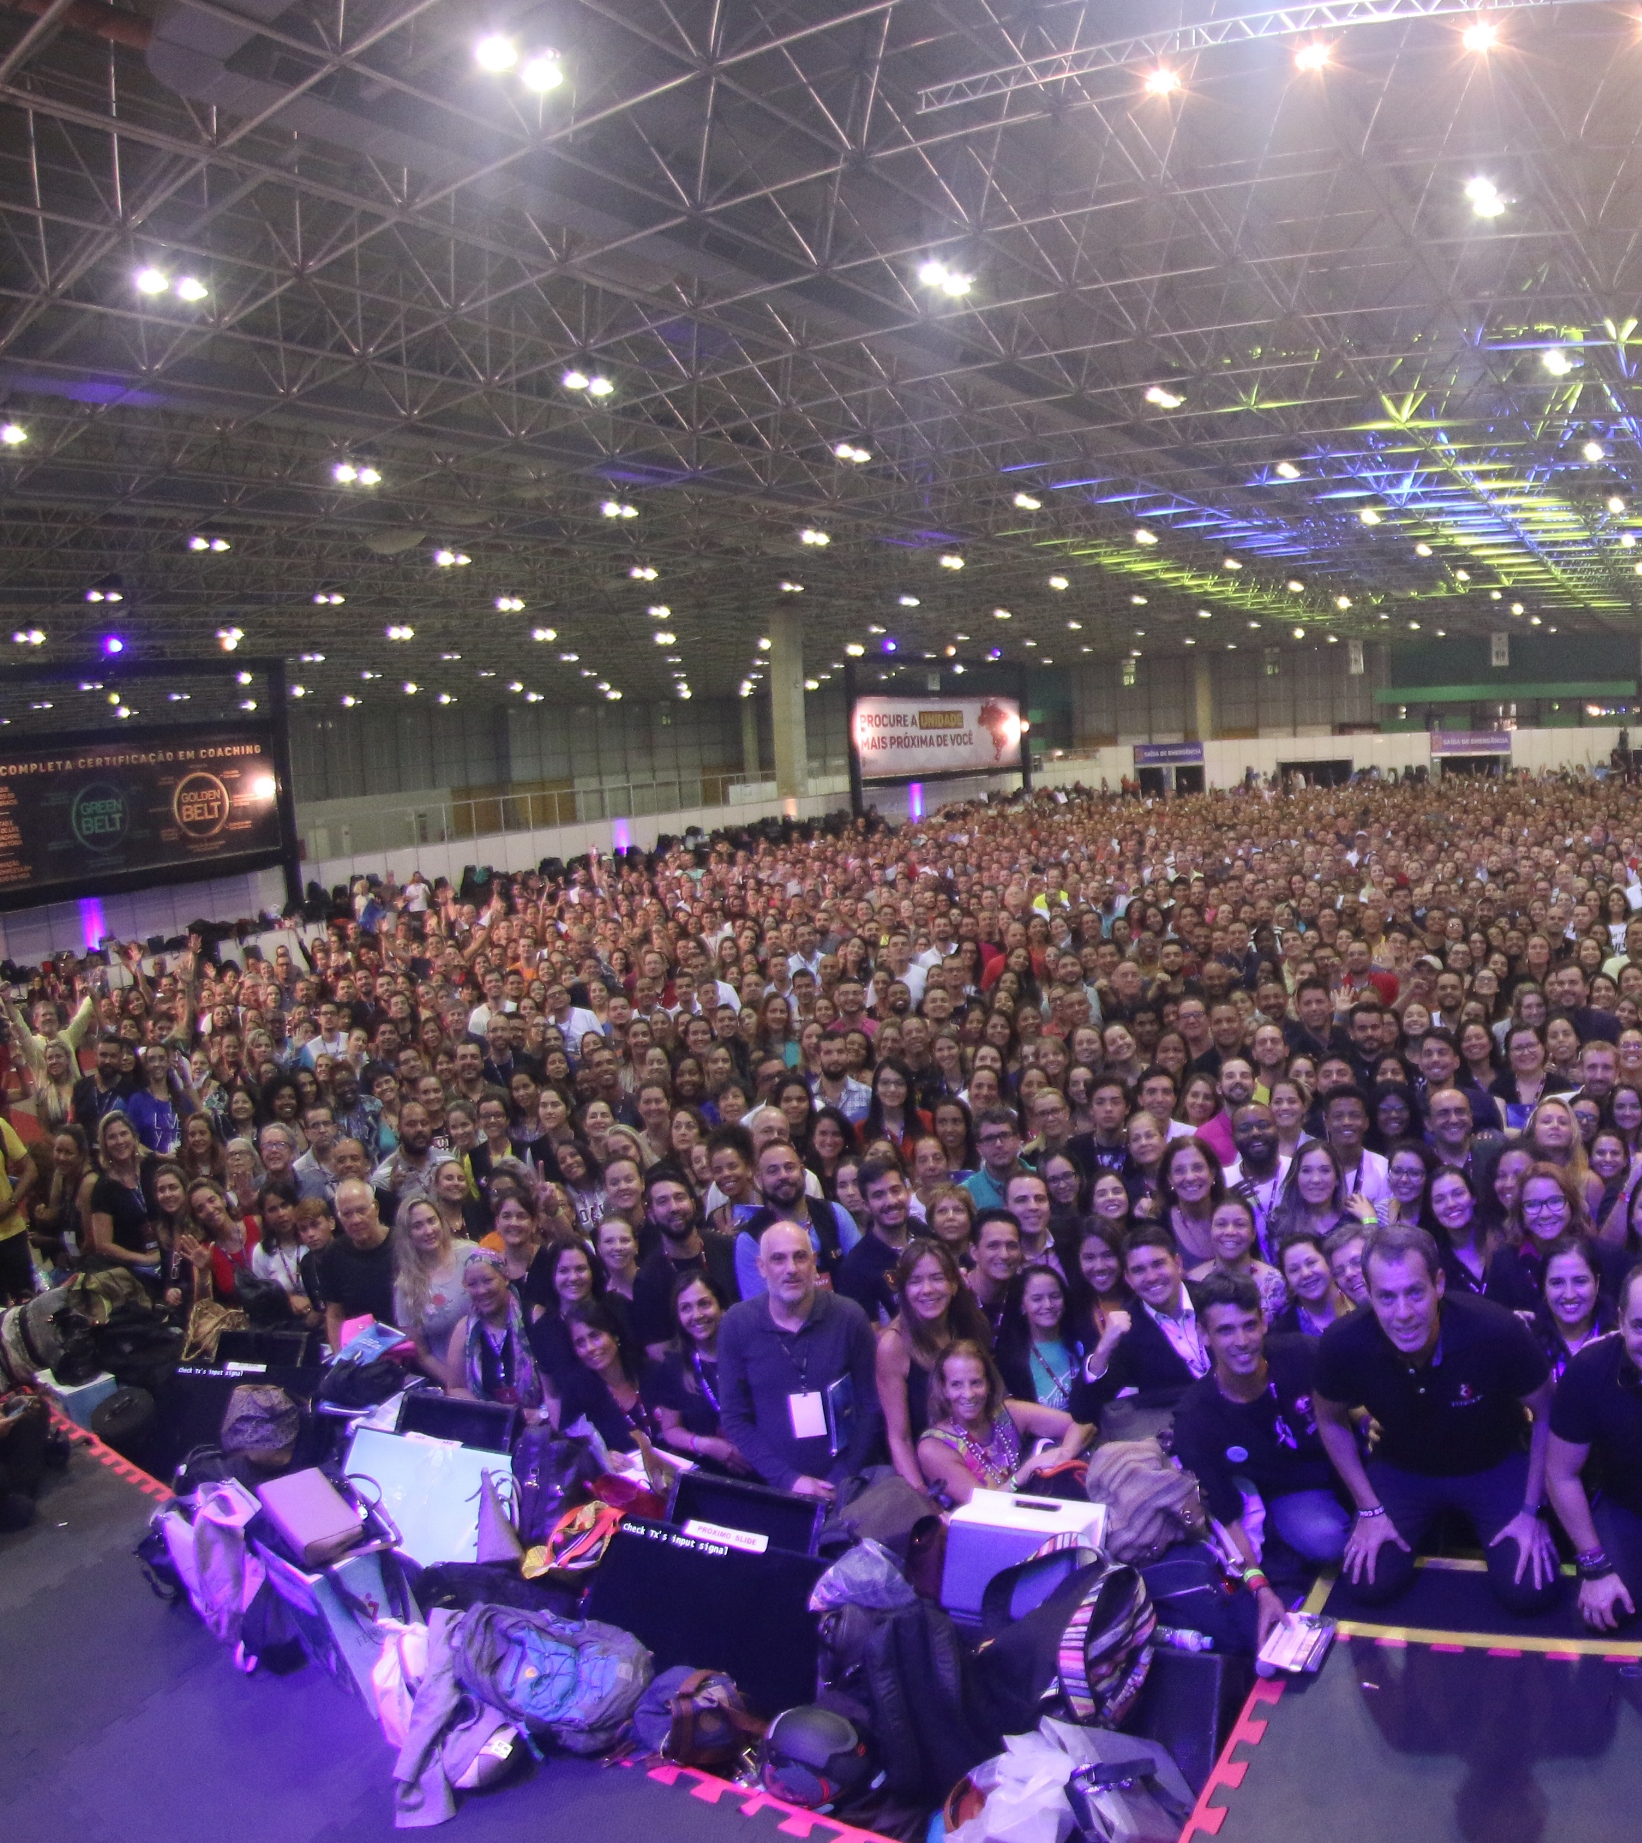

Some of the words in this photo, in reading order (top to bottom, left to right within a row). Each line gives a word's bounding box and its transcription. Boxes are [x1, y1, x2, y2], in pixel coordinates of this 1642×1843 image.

[860, 714, 908, 729] PROCURE
[911, 714, 918, 727] A
[920, 712, 963, 728] UNIDADE
[861, 736, 888, 750] MAIS
[889, 733, 935, 748] PRÓXIMA
[936, 735, 948, 747] DE
[949, 731, 973, 746] VOCÊ
[0, 760, 73, 776] COMPLETA
[78, 750, 174, 769] CERTIFICAÇÃO
[178, 750, 195, 760] EM
[200, 744, 261, 759] COACHING
[181, 789, 221, 802] GOLDEN
[80, 800, 122, 816] GREEN
[182, 802, 221, 822] BELT
[81, 814, 122, 836] BELT
[672, 1534, 696, 1548] input
[699, 1542, 729, 1556] signal
[735, 1534, 758, 1546] SLIDE
